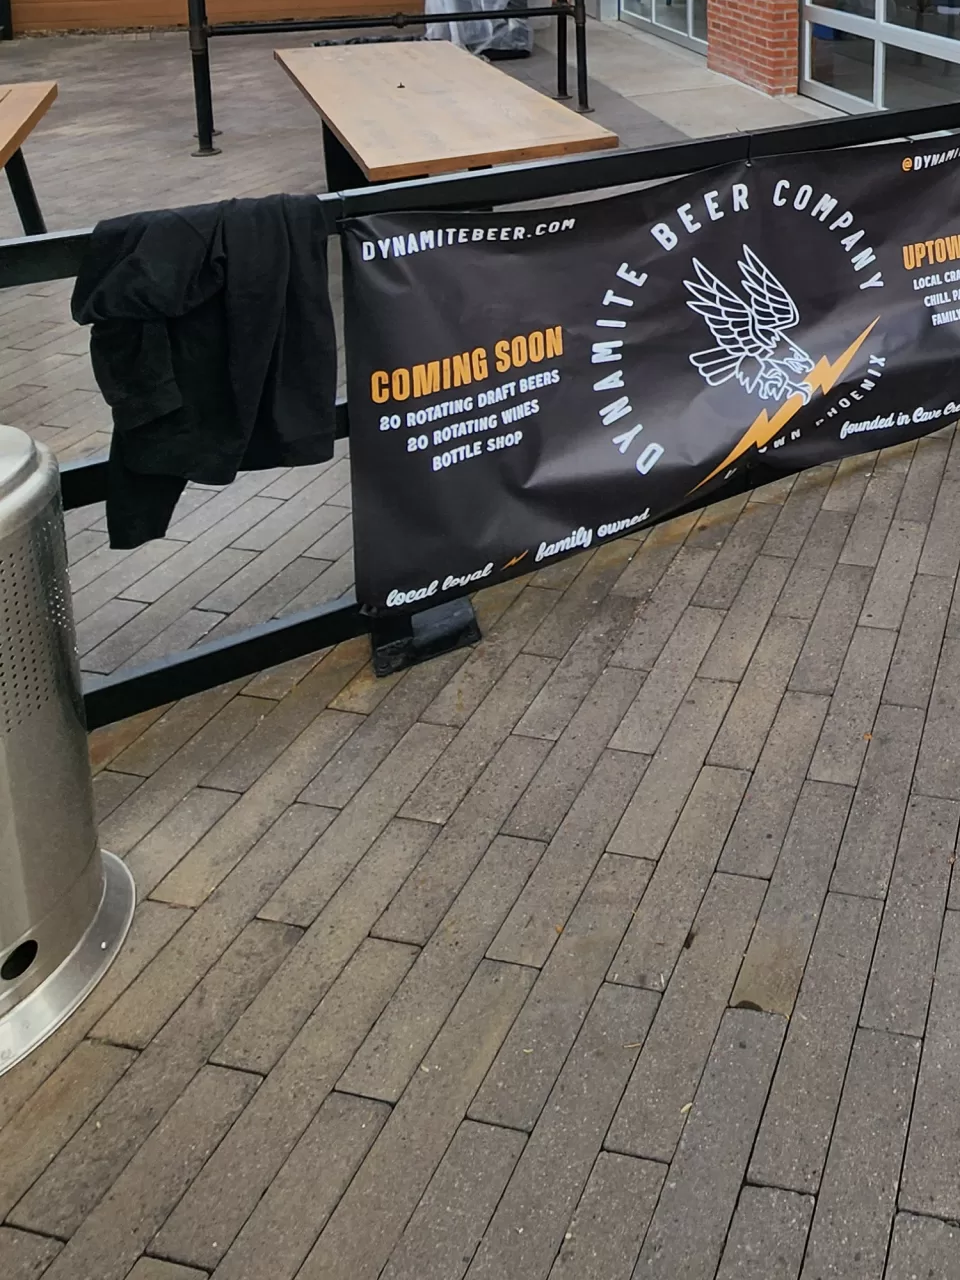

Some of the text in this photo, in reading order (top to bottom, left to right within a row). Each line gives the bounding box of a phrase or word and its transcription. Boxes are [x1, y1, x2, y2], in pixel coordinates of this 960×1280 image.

[362, 218, 576, 261] DYNAMITEBEER.COM
[913, 273, 942, 290] LOCAL
[924, 292, 951, 307] CHILL
[591, 262, 664, 475] DYNAMITE
[650, 183, 749, 251] BEER
[772, 179, 884, 290] COMPANY
[371, 326, 563, 403] COMING SOON
[379, 369, 560, 430] 20 ROTATING DRAFT BEERS
[840, 412, 895, 439] founded
[897, 412, 910, 426] in
[912, 407, 942, 423] Cave
[407, 399, 540, 452] 20 ROTATING WINES
[432, 431, 523, 471] BOTTLE SHOP
[385, 507, 650, 607] local loyal family owned
